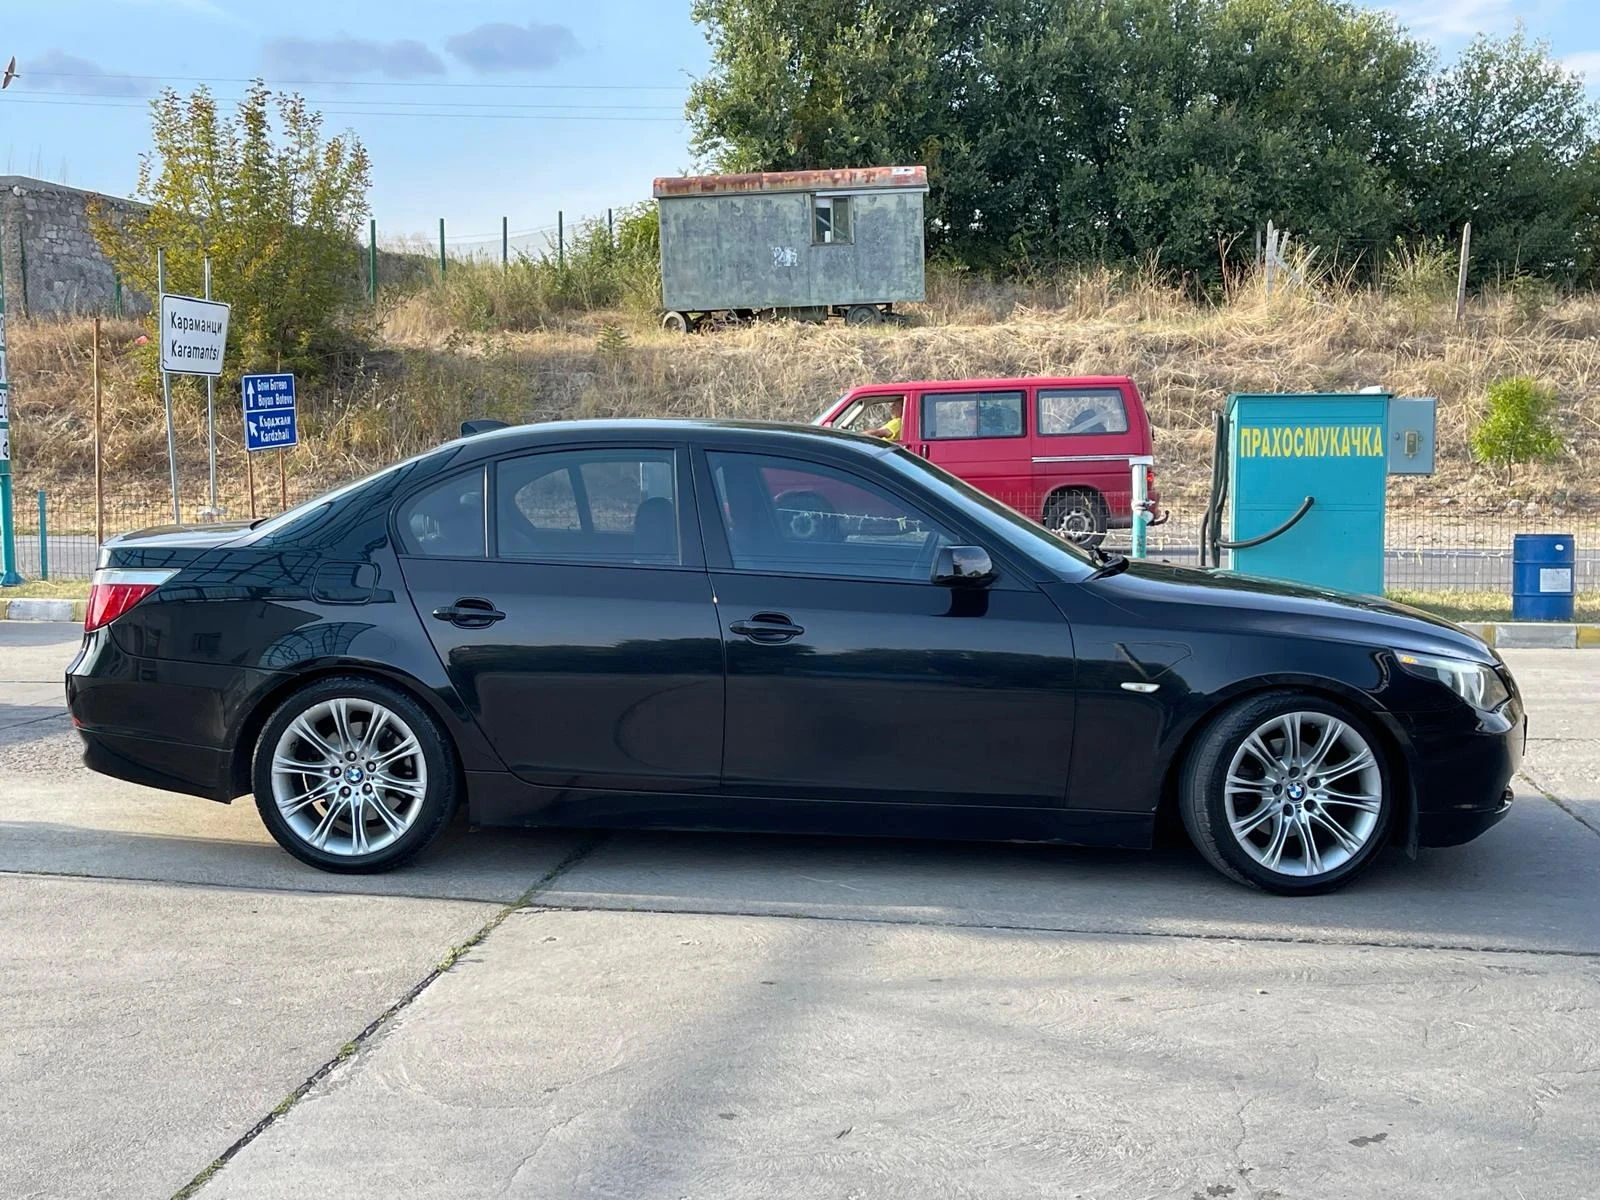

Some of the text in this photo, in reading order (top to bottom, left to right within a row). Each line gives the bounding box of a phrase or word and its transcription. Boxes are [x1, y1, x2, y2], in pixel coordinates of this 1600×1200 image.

[171, 311, 222, 336] Караманци
[171, 339, 220, 360] Karamantsi
[260, 428, 290, 442] Kardzhali
[1240, 426, 1384, 458] ПРАХОСМУКАЧКА
